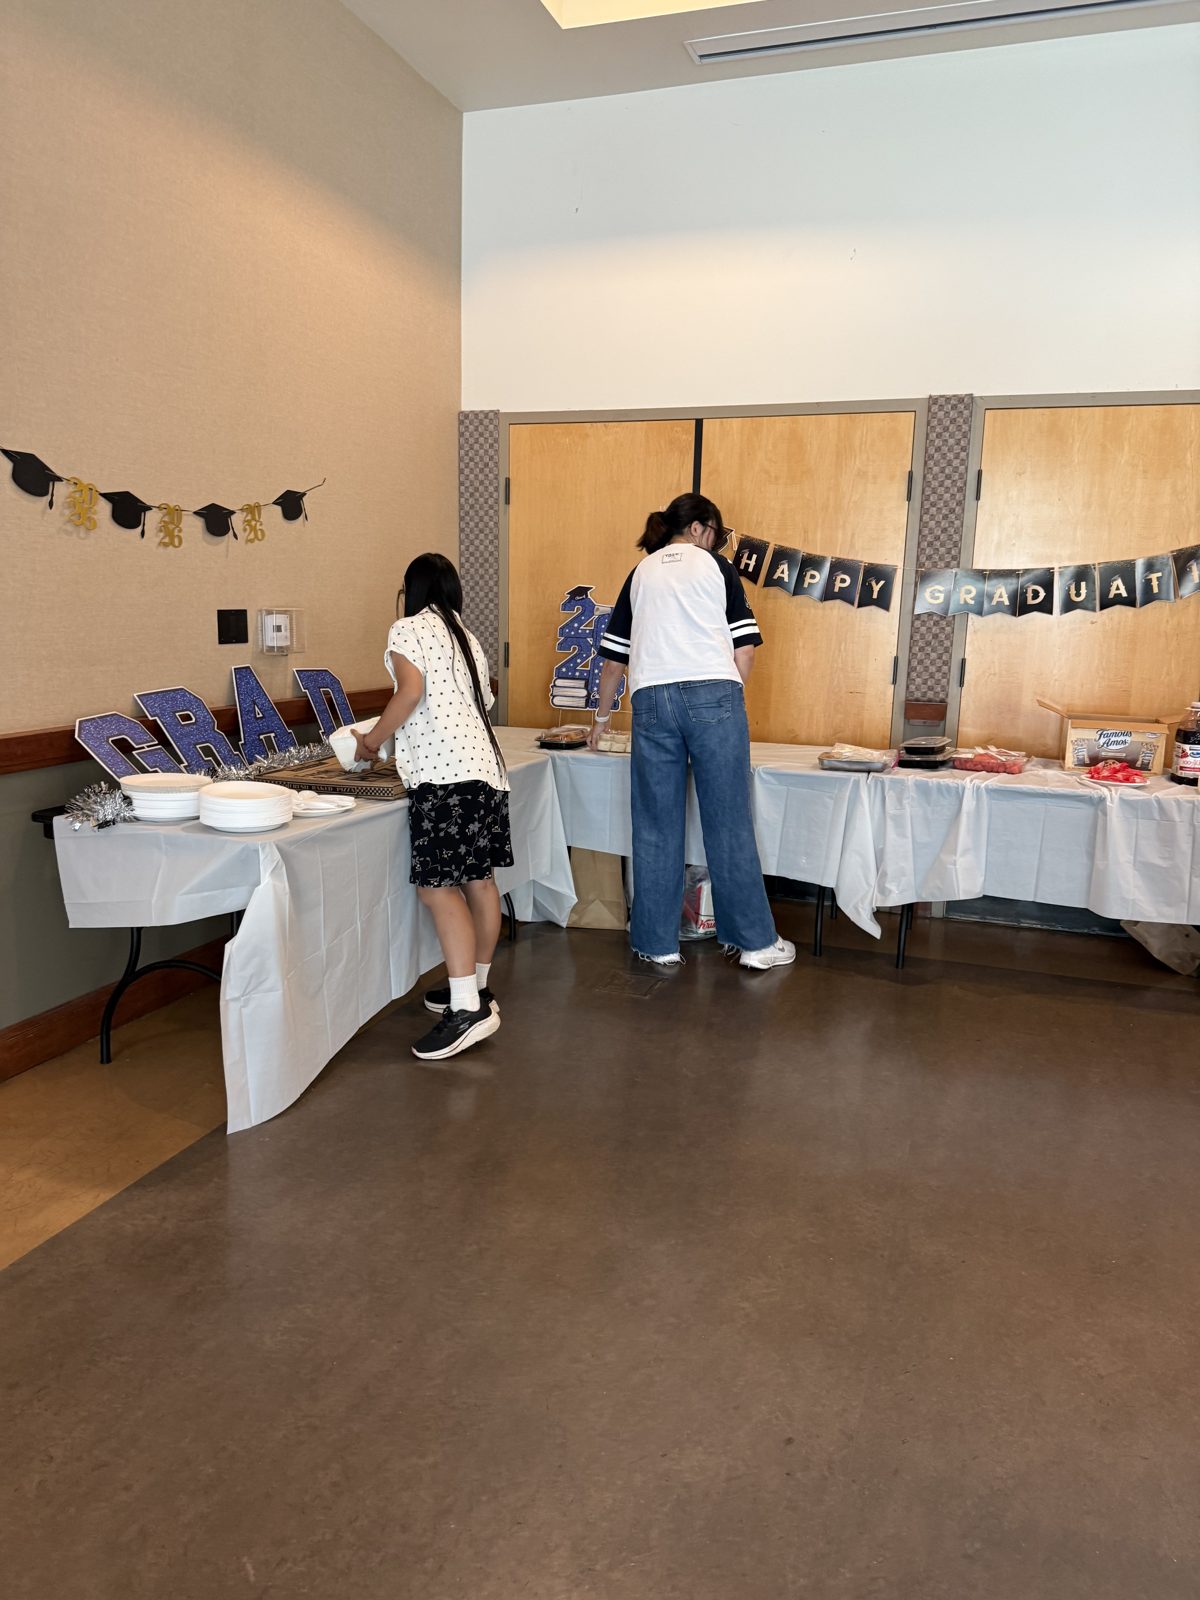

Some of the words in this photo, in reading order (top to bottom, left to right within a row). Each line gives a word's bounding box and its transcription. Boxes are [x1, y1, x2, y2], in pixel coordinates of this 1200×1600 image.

[158, 503, 182, 527] 20
[242, 502, 261, 523] 20
[159, 520, 183, 548] 26
[243, 519, 265, 544] 26
[739, 551, 886, 599] HAPPY
[75, 664, 358, 781] GRAD
[1095, 729, 1133, 741] Famous
[1097, 738, 1128, 749] Amos
